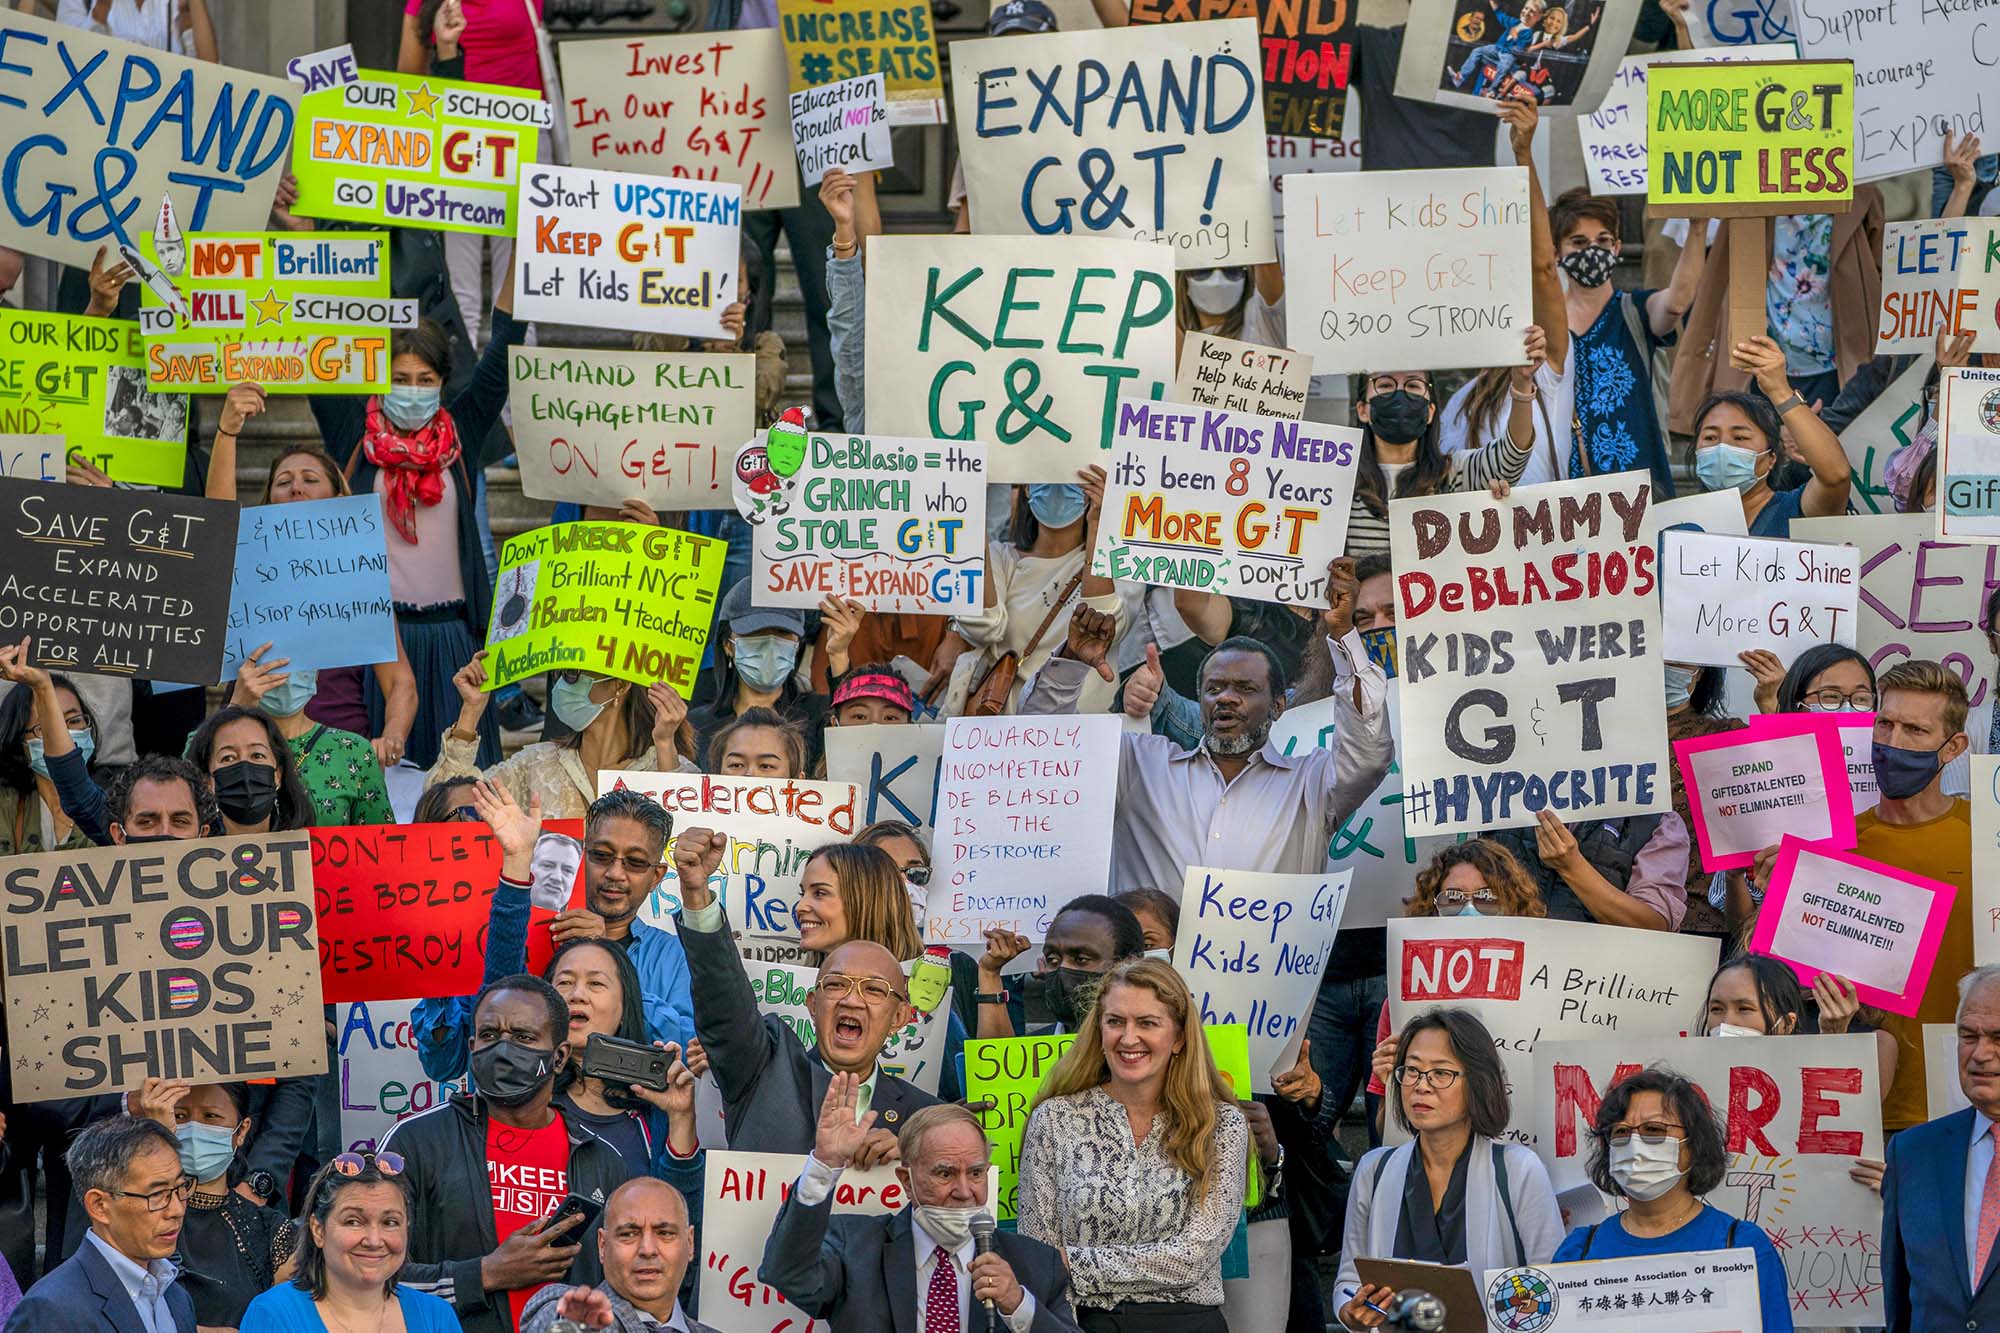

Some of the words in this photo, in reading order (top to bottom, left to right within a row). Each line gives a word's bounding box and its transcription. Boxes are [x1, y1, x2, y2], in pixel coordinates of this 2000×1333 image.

[784, 6, 930, 44] INCREASE
[288, 55, 358, 94] SAVE
[626, 42, 733, 77] Invest
[801, 45, 936, 84] #SEATS
[0, 28, 294, 181] EXPAND
[345, 85, 396, 109] OUR
[448, 94, 551, 125] SCHOOLS
[571, 98, 610, 128] In
[624, 98, 674, 120] Our
[700, 84, 767, 119] Kids
[791, 79, 877, 120] Education
[976, 54, 1255, 137] EXPAND
[1657, 89, 1748, 132] MORE
[1755, 83, 1843, 133] G&T
[845, 105, 872, 128] NOT
[1589, 104, 1629, 130] NOT
[1859, 92, 1985, 163] Expand
[313, 121, 431, 168] EXPAND
[592, 128, 666, 158] Fund
[798, 132, 872, 173] Political
[1663, 150, 1741, 194] NOT
[1758, 148, 1849, 193] LESS
[337, 183, 373, 204] GO
[529, 173, 599, 209] Start
[614, 183, 739, 226] UPSTREAM
[1315, 194, 1365, 237] Let
[1458, 186, 1529, 228] Shine
[192, 243, 261, 278] NOT
[1897, 230, 1968, 275] LET
[523, 262, 564, 296] Let
[579, 268, 628, 301] Kids
[1331, 253, 1407, 304] Keep
[1425, 253, 1499, 292] G&T
[141, 308, 175, 330] TO
[190, 291, 243, 322] KILL
[294, 298, 413, 324] SCHOOLS
[918, 266, 1175, 360] KEEP
[1320, 309, 1392, 341] Q300
[1408, 303, 1513, 338] STRONG
[1879, 288, 1980, 340] SHINE
[10, 321, 58, 346] OUR
[66, 320, 119, 352] KIDS
[1200, 340, 1232, 369] Keep
[515, 354, 635, 387] DEMAND
[655, 363, 745, 389] REAL
[1197, 365, 1226, 392] Help
[1232, 372, 1258, 391] Kids
[1261, 379, 1305, 403] Achieve
[532, 393, 716, 430] ENGAGEMENT
[1192, 387, 1219, 405] Their
[1224, 394, 1248, 412] Full
[550, 437, 599, 478] ON
[811, 437, 918, 472] DeBlasio
[946, 447, 982, 472] the
[804, 477, 910, 512] GRINCH
[925, 481, 967, 513] who
[1161, 456, 1215, 490] been
[1225, 458, 1250, 496] 8
[1266, 467, 1333, 506] Years
[552, 524, 637, 554] WRECK
[776, 517, 879, 551] STOLE
[1412, 484, 1650, 560] DUMMY
[256, 563, 278, 583] SO
[288, 553, 388, 581] BRILLIANT
[768, 561, 833, 592] SAVE
[1680, 545, 1722, 577] Let
[1736, 546, 1786, 582] Kids
[1796, 550, 1851, 585] Shine
[1275, 577, 1326, 602] CUT
[254, 604, 293, 624] STOP
[298, 596, 392, 626] GASLIGHTING
[540, 595, 607, 628] Burden
[614, 597, 632, 626] 4
[634, 601, 707, 645] teachers
[1696, 603, 1759, 636] More
[495, 635, 586, 686] Acceleration
[597, 634, 618, 669] 4
[622, 640, 695, 687] NONE
[1405, 630, 1516, 684] KIDS
[1535, 619, 1646, 666] WERE
[945, 760, 1082, 782] INCOMPETENT
[1711, 774, 1806, 799] GIFTED&TALENTED
[1732, 760, 1774, 777] EXPAND
[947, 790, 976, 809] DE
[988, 789, 1080, 807] BLASIO
[1404, 763, 1657, 825] #HYPOCRITE
[1719, 804, 1738, 817] NOT
[1740, 793, 1805, 814] ELIMINATE!!!
[954, 817, 977, 836] IS
[1006, 815, 1053, 832] THE
[428, 835, 495, 861] LET
[953, 844, 1062, 864] DESTROYER
[4, 857, 169, 914] SAVE
[177, 840, 310, 899] G&T
[951, 870, 977, 886] OF
[1837, 882, 1882, 905] EXPAND
[315, 887, 354, 918] DE
[374, 879, 473, 911] BOZO
[953, 893, 1047, 912] EDUCATION
[1199, 873, 1293, 944] Keep
[1802, 892, 1905, 934] GIFTED&TALENTED
[5, 913, 131, 976] LET
[160, 901, 315, 960] OUR
[1801, 911, 1825, 928] NOT
[1826, 920, 1894, 951] ELIMINATE!!!
[319, 930, 463, 974] DESTROY
[1190, 934, 1260, 973] Kids
[84, 962, 255, 1028] KIDS
[1411, 949, 1514, 994] NOT
[1530, 964, 1549, 989] A
[1563, 968, 1679, 1006] Brilliant
[1560, 998, 1619, 1031] Plan
[62, 1020, 276, 1090] SHINE
[719, 1167, 766, 1202] All
[1557, 1279, 1588, 1289] United
[1594, 1275, 1629, 1286] Chinese
[1635, 1269, 1687, 1283] Association
[1694, 1265, 1706, 1275] Of
[1713, 1262, 1755, 1273] Brooklyn
